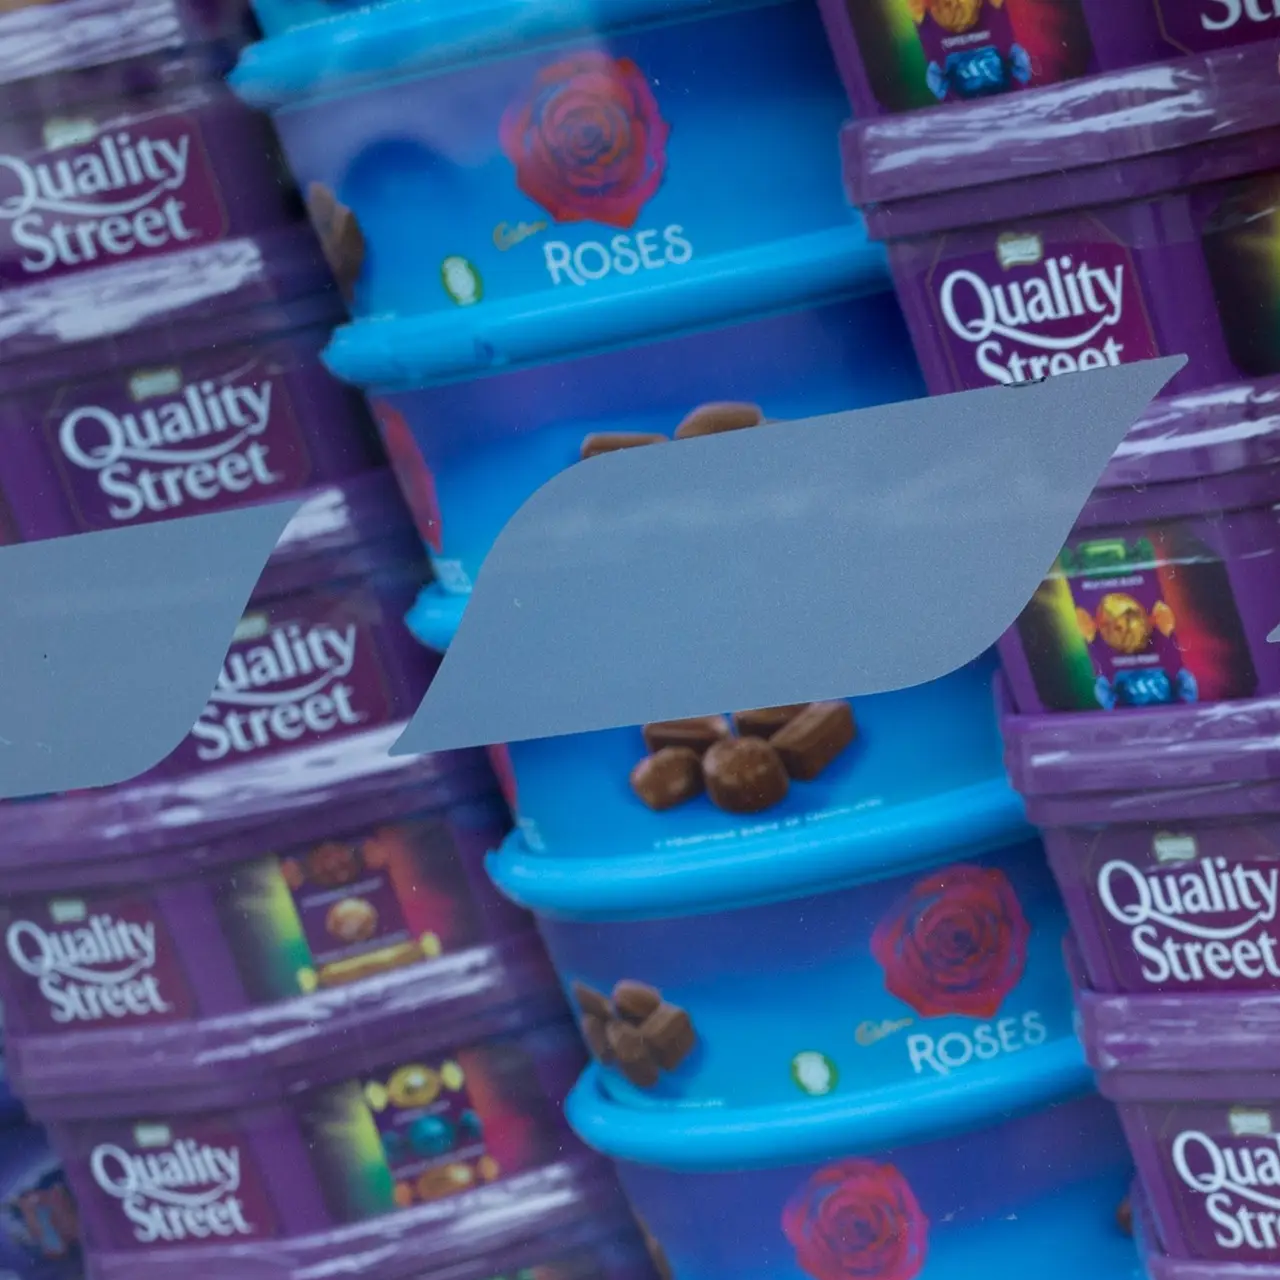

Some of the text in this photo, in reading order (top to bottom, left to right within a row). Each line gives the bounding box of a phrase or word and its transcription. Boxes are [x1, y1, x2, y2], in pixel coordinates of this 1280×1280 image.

[11, 198, 192, 272] Street
[543, 224, 693, 287] ROSES
[940, 256, 1124, 349] Quality
[58, 380, 272, 470] Quality
[98, 440, 275, 520] Street
[212, 623, 357, 705] uality
[193, 685, 358, 762] Street
[1098, 855, 1279, 937] Quality
[7, 918, 156, 985] Quality
[40, 968, 167, 1021] Street
[907, 1012, 1048, 1075] ROSES
[90, 1138, 240, 1203] Quality
[122, 1195, 250, 1243] Street
